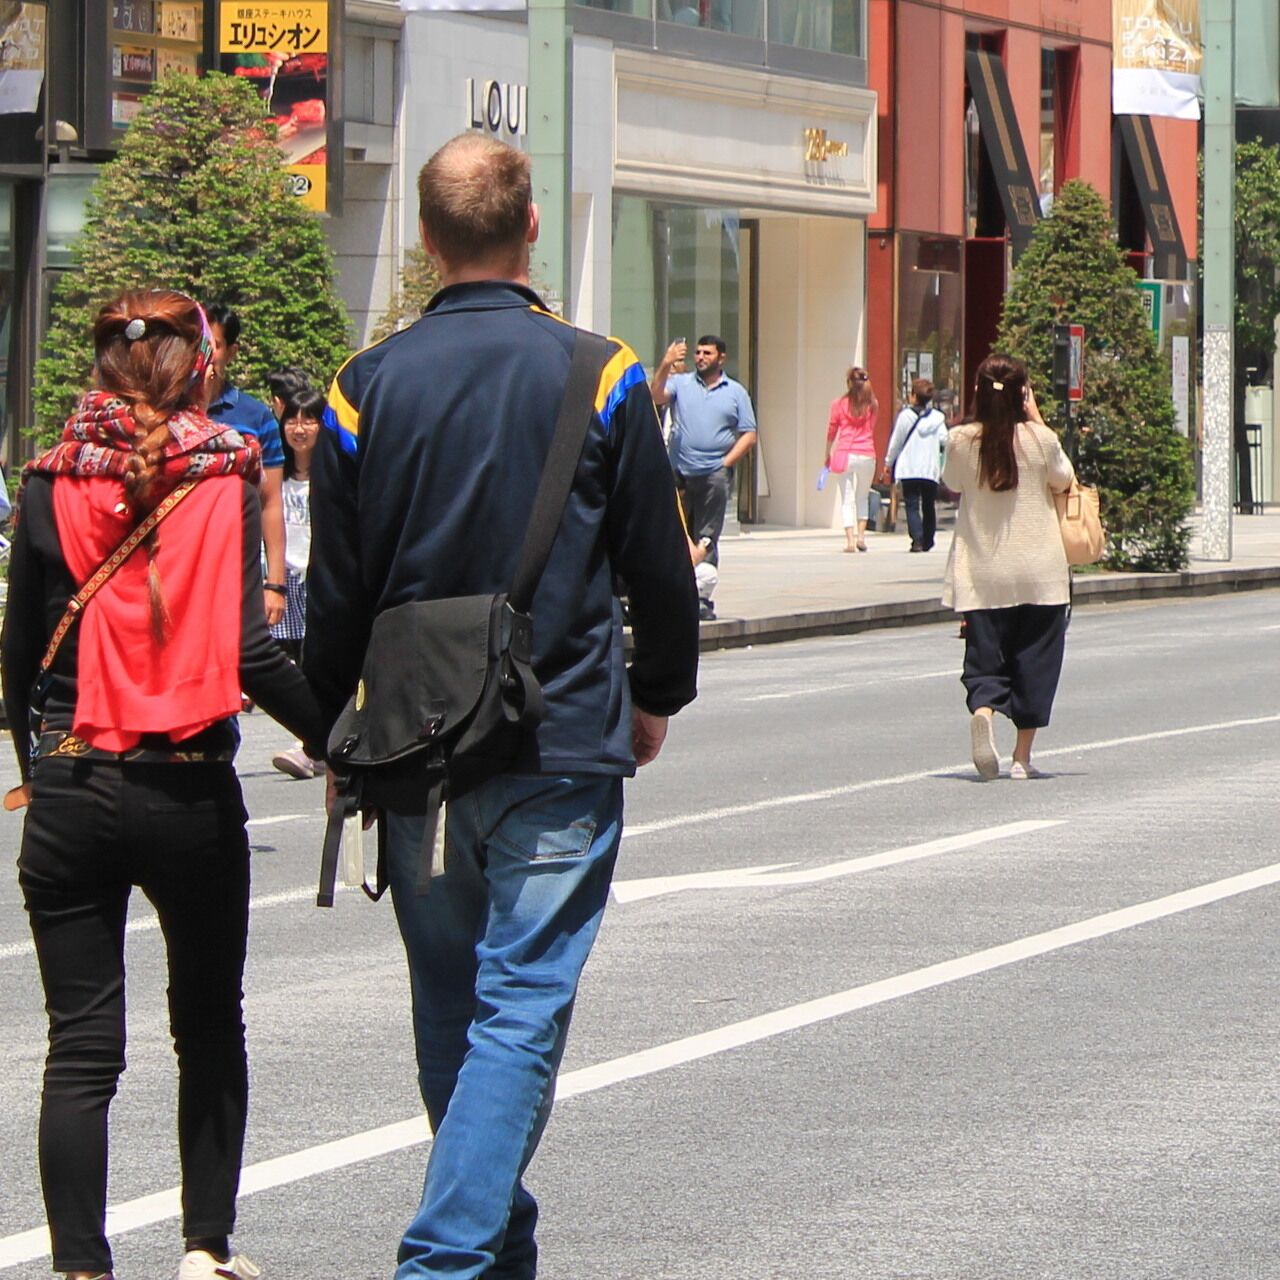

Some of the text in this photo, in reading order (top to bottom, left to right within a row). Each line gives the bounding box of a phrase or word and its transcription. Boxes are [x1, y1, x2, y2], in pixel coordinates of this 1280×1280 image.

[228, 22, 321, 50] エリュシオン
